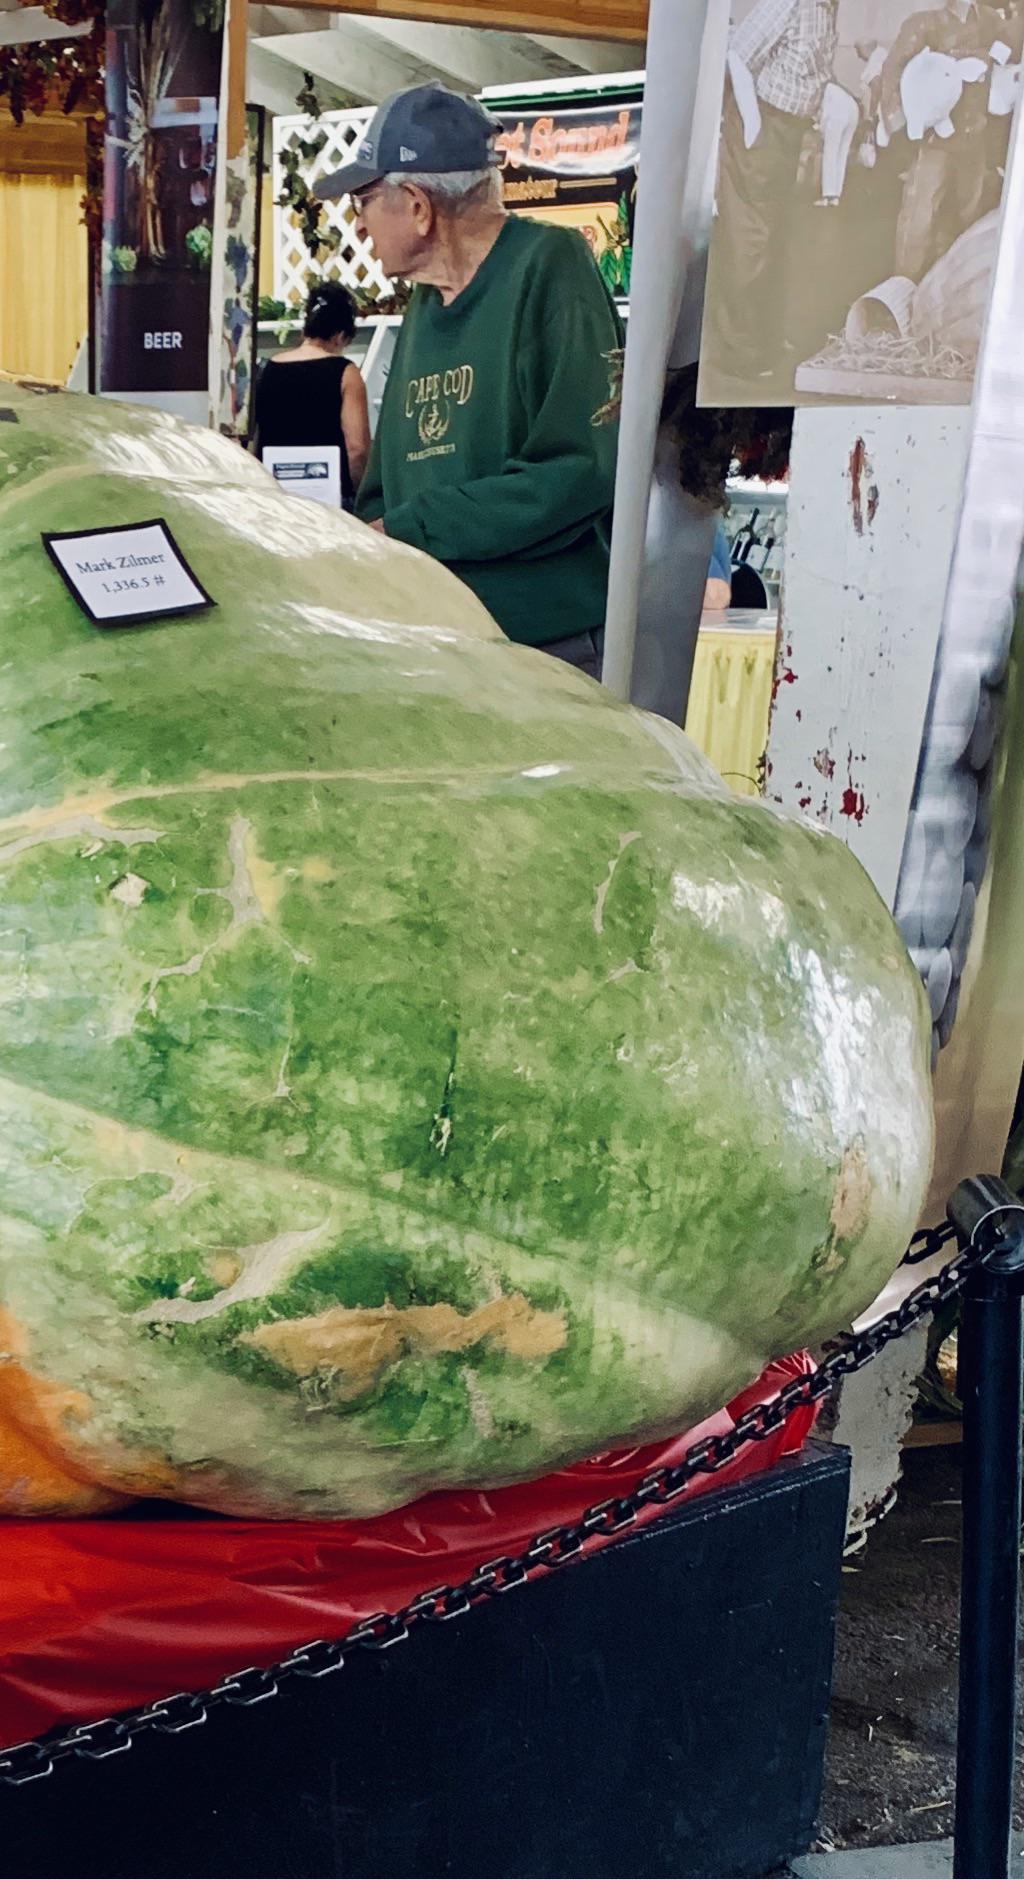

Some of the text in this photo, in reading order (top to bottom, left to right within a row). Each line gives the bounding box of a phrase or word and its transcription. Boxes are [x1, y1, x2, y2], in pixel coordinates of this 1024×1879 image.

[143, 331, 183, 349] BEER
[405, 364, 474, 418] CAPE COD
[75, 553, 166, 574] Mark Zilmer
[102, 577, 149, 593] 1,336.5
